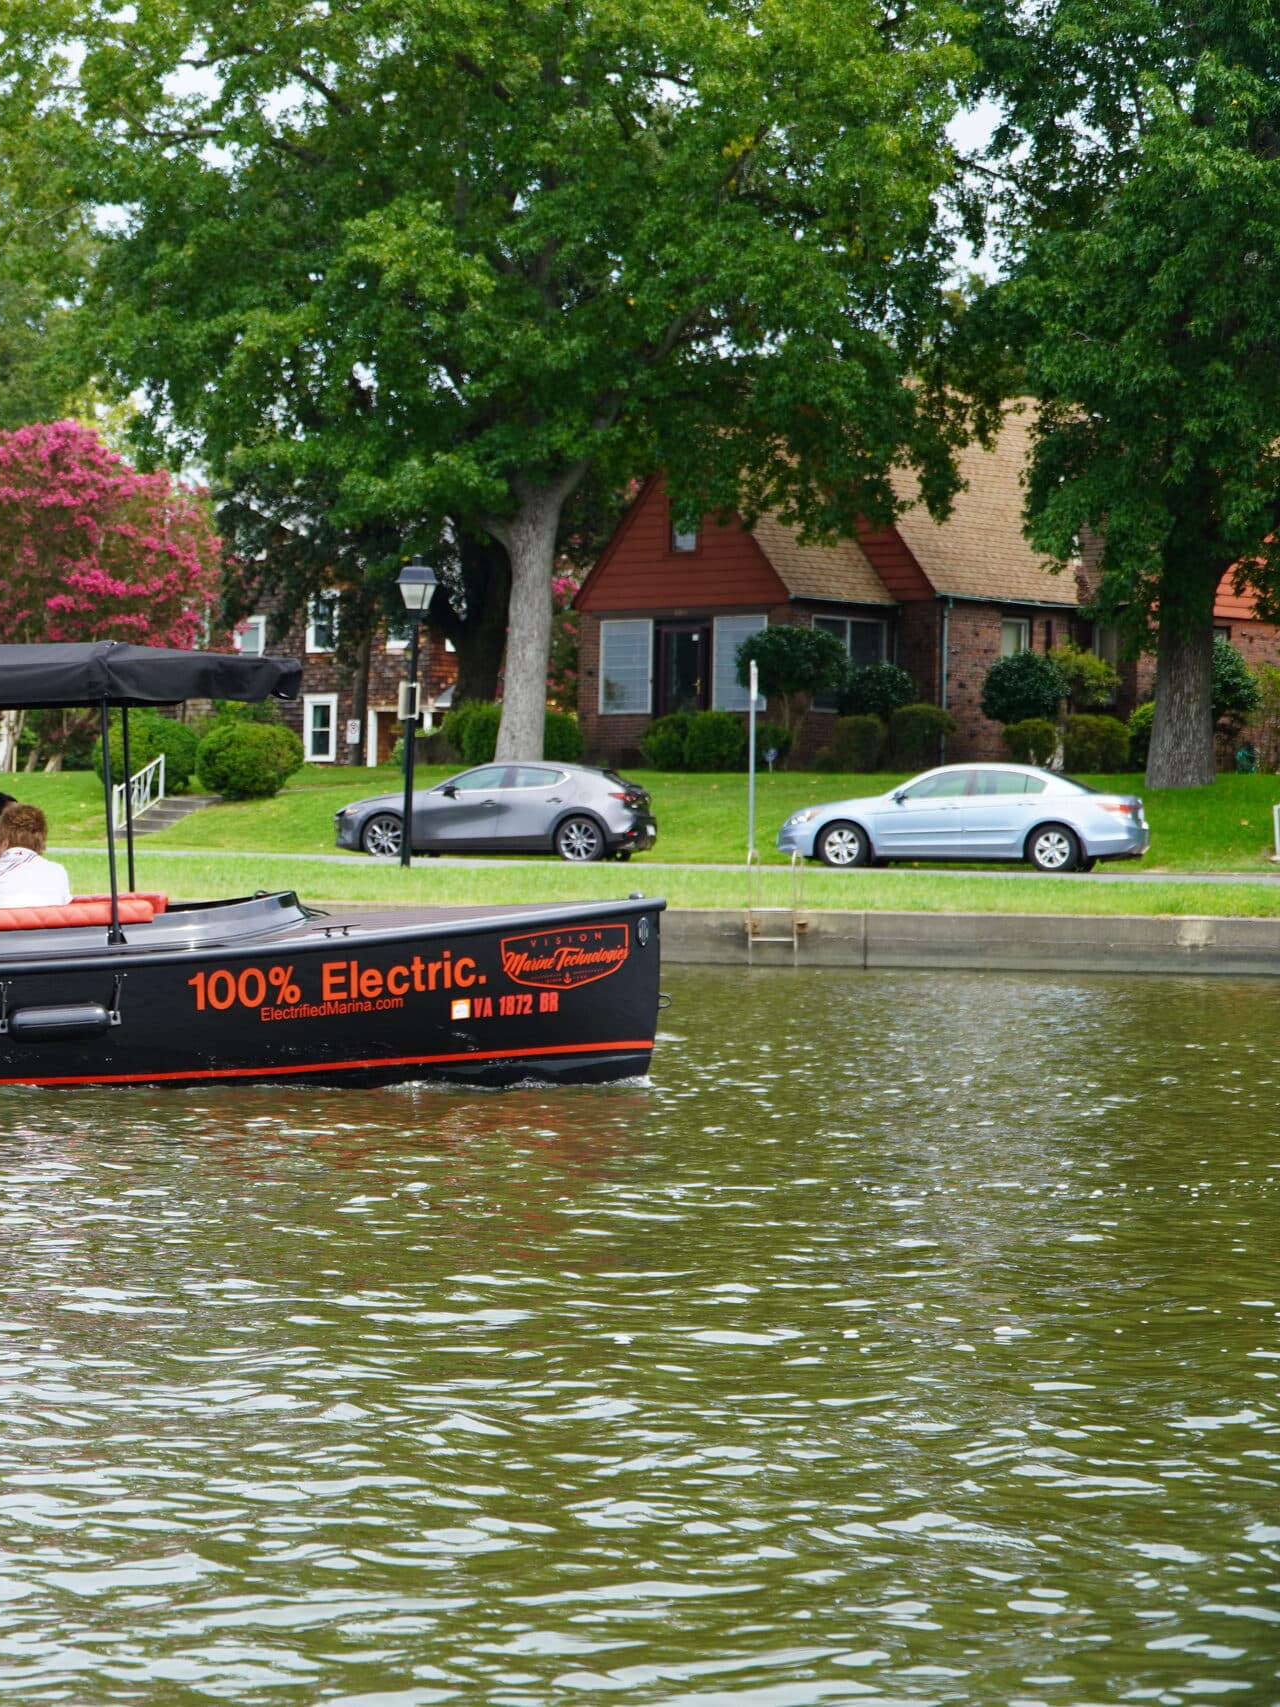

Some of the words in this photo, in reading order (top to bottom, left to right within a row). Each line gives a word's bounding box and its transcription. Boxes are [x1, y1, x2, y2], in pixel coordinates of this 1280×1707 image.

[530, 931, 602, 948] VISION
[504, 951, 555, 977] Marine
[553, 945, 629, 971] Technologies
[187, 966, 302, 1011] 100%
[322, 950, 487, 1001] Electric.
[260, 996, 404, 1022] ElectrifiedMarina.com
[473, 997, 493, 1018] VA
[499, 993, 533, 1016] 1872
